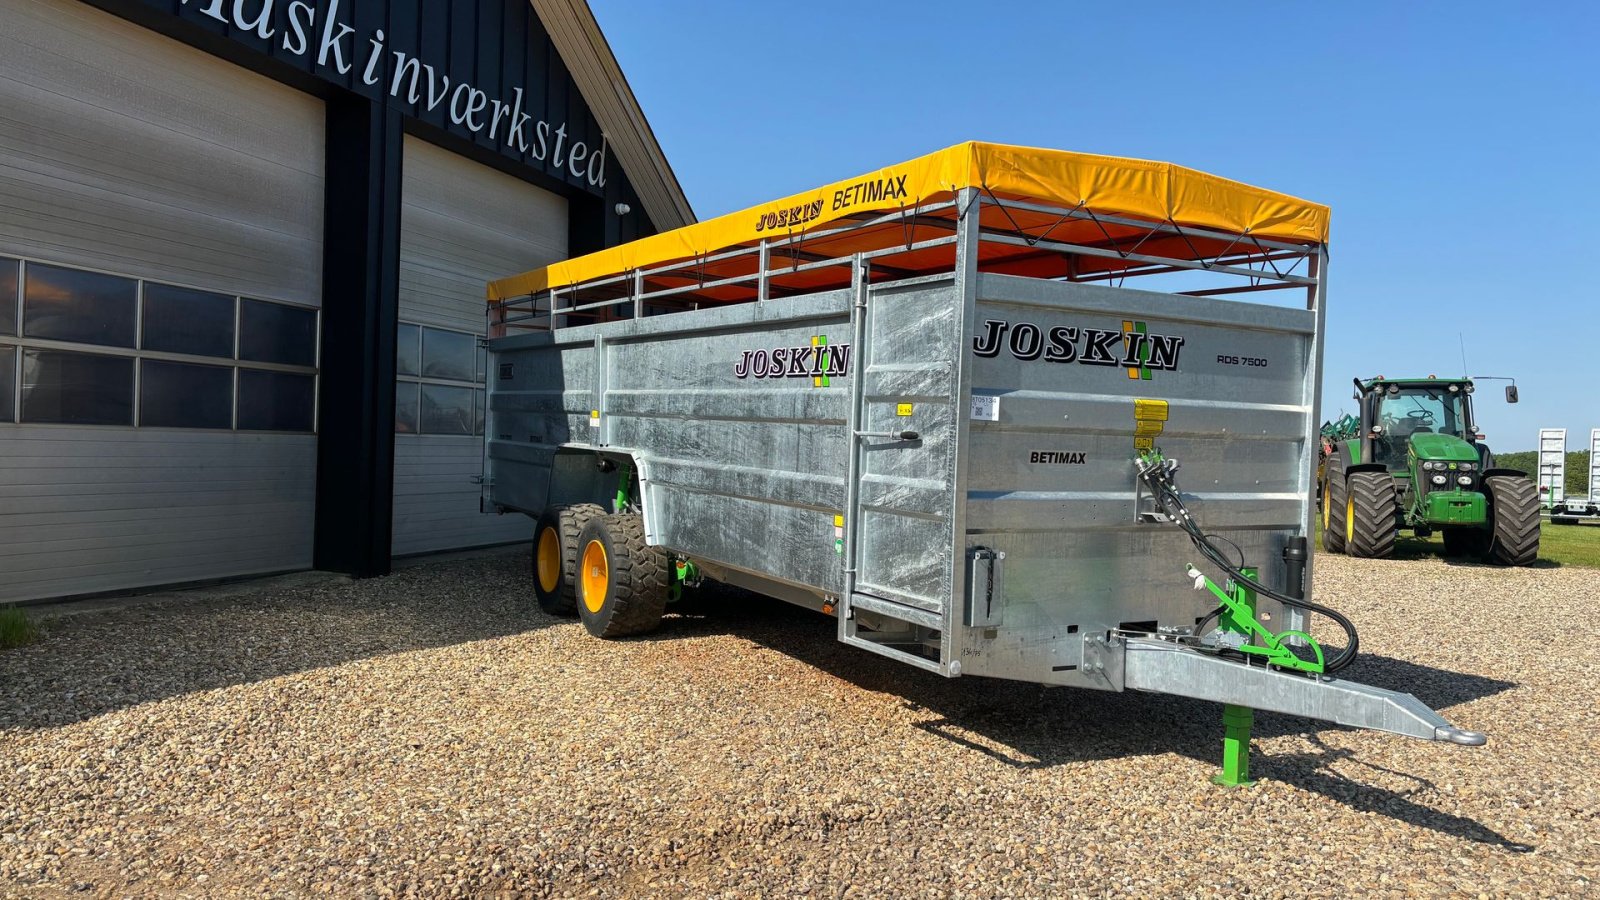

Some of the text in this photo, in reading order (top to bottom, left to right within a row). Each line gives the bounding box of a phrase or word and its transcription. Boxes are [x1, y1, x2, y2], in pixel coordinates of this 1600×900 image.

[755, 174, 908, 232] JOSKIN BETIMAX
[735, 343, 850, 379] JOSKIN
[973, 319, 1185, 371] JOSKIN
[1216, 355, 1268, 368] RDS 7500
[1030, 451, 1087, 465] BETIMAX
